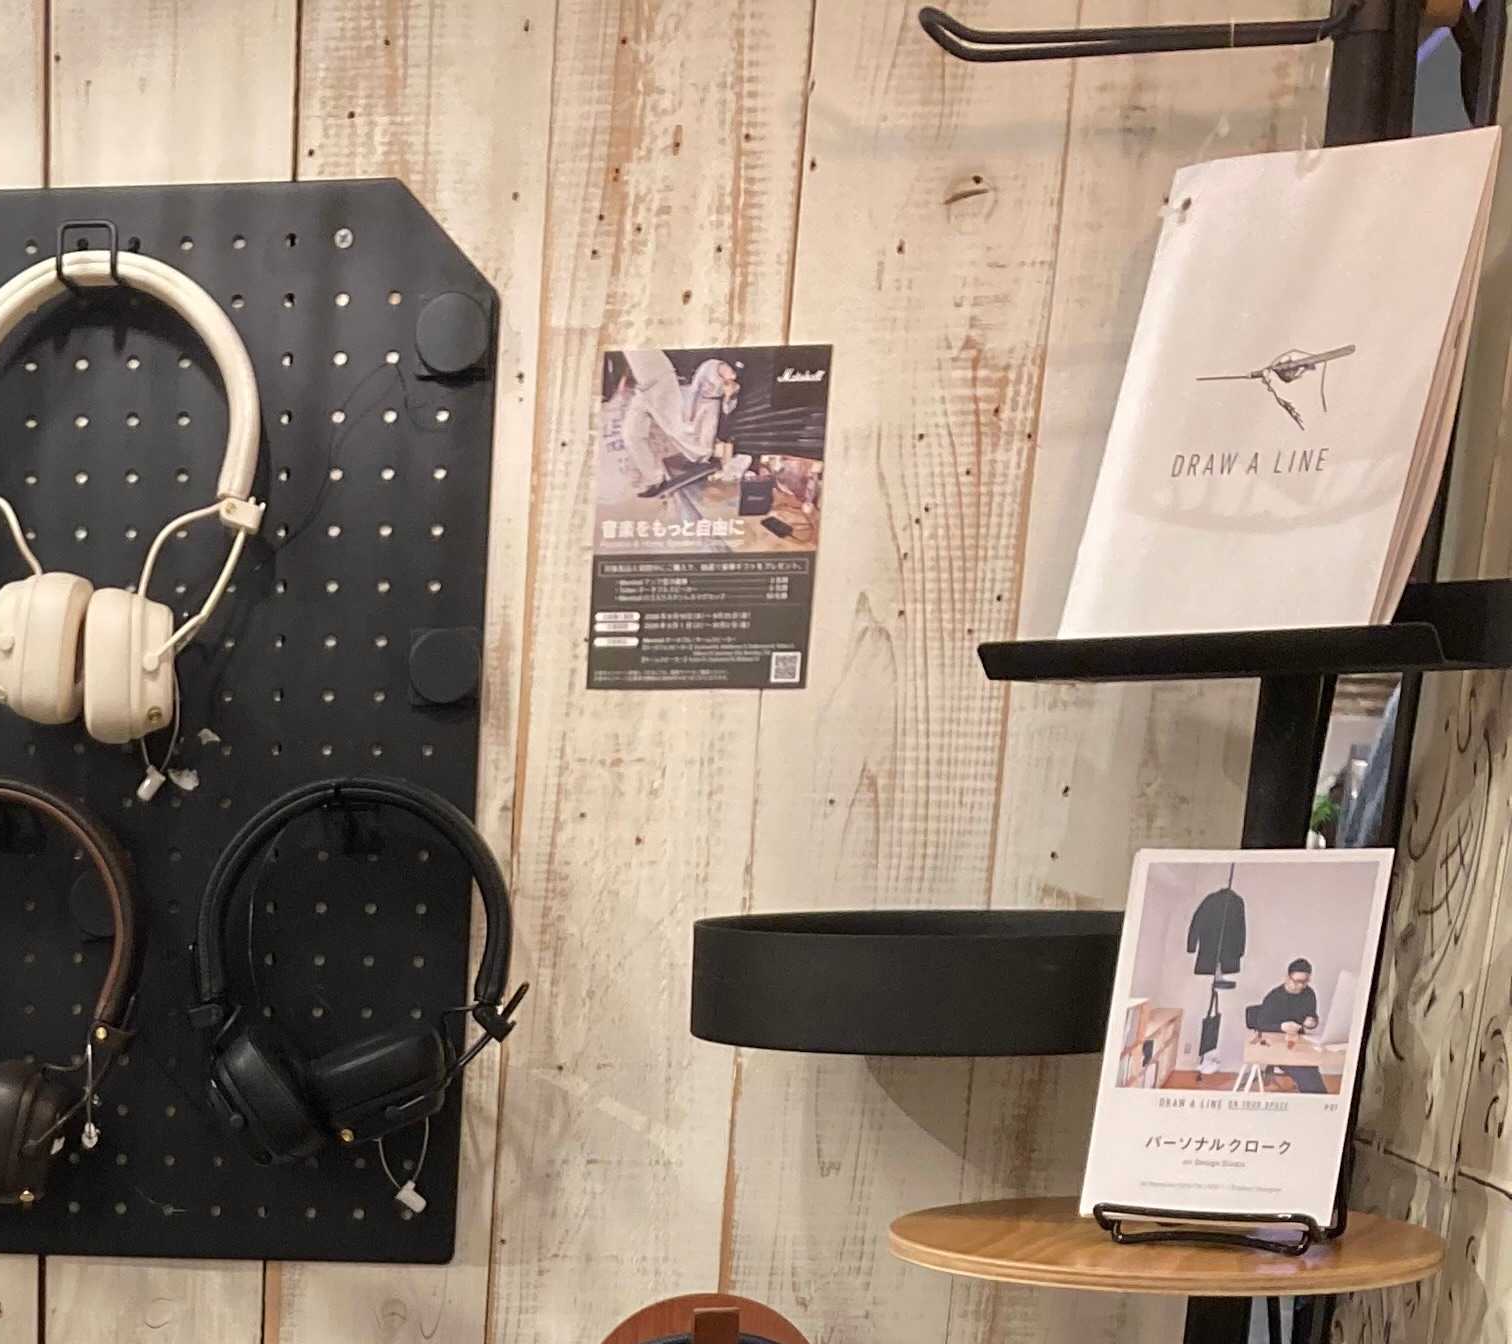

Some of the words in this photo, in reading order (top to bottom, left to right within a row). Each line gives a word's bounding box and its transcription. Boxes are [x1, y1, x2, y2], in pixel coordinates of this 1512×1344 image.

[1171, 452, 1239, 477] DRAW
[1246, 452, 1259, 475] A
[1273, 448, 1330, 473] LINE
[1159, 1097, 1186, 1109] DRAW
[1199, 1098, 1222, 1110] LINE
[1145, 1136, 1292, 1156] パーソナルクローク
